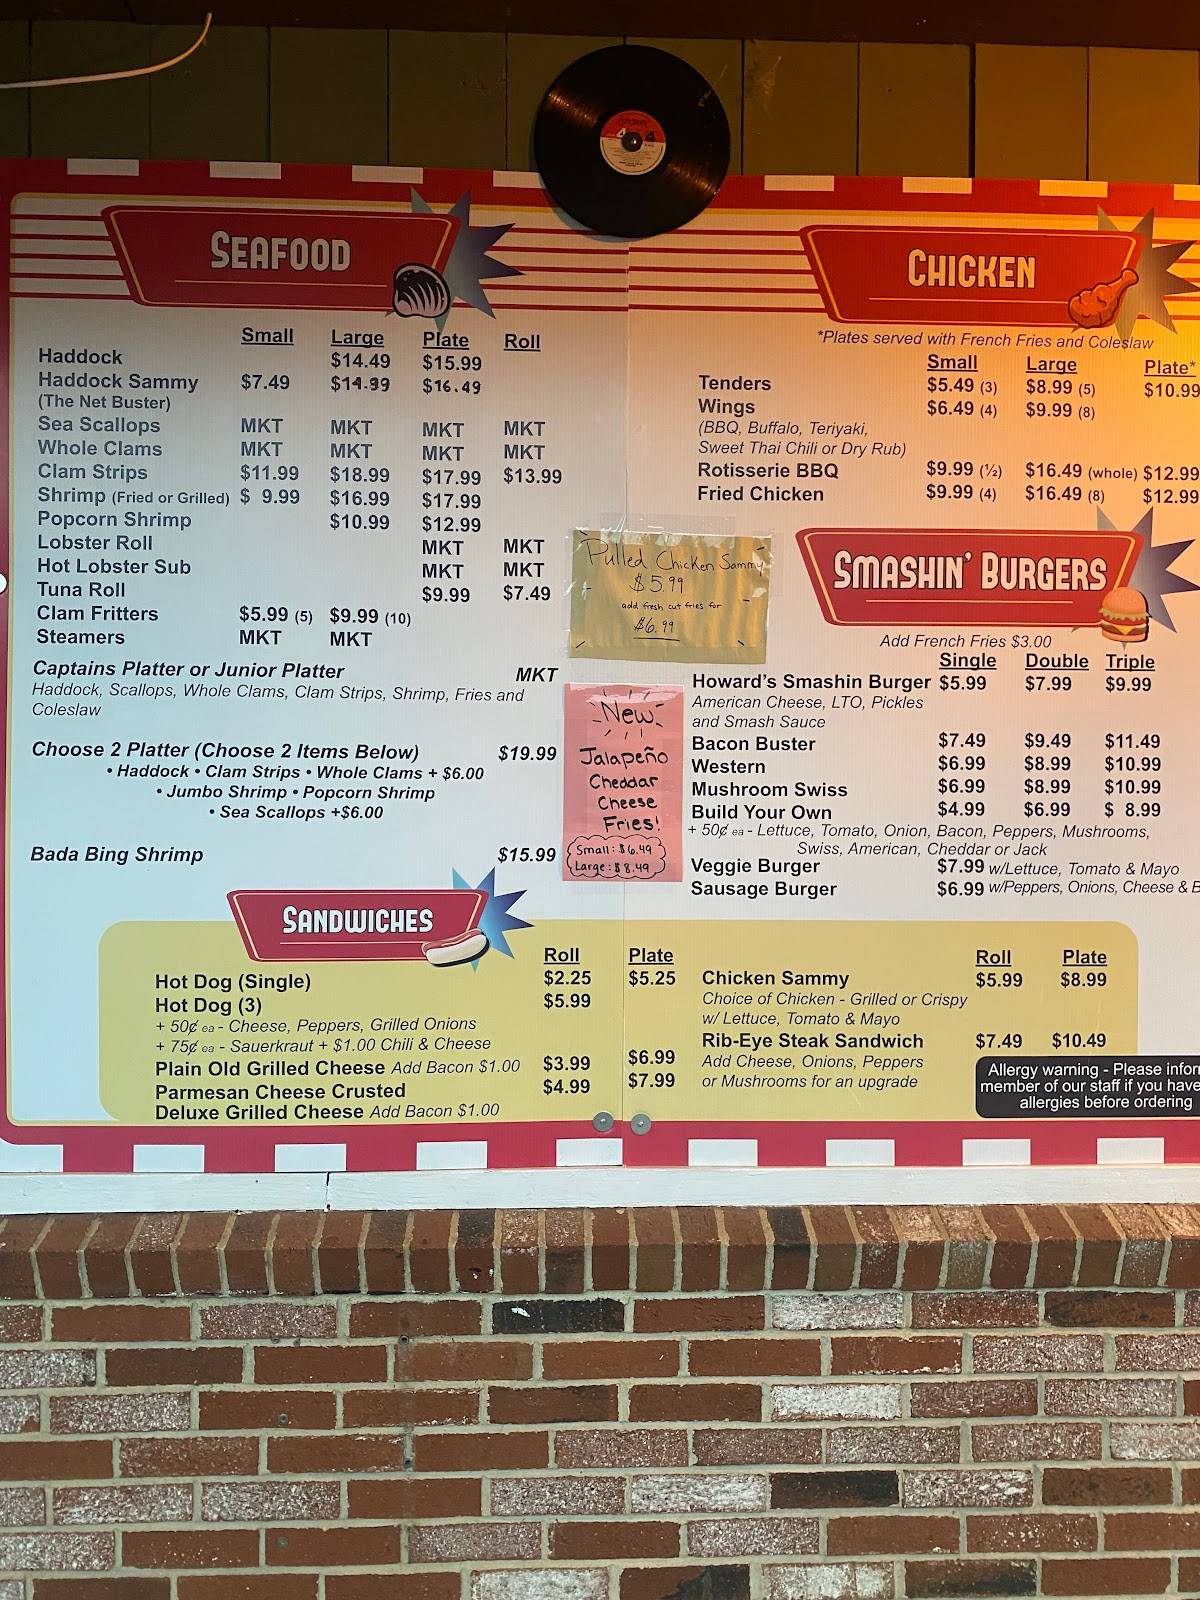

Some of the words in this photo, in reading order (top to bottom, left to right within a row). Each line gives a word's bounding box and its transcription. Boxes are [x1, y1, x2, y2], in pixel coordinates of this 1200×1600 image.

[210, 230, 351, 272] SEAFOOD
[908, 248, 1036, 289] CHICKEN
[241, 327, 294, 345] Small
[331, 329, 384, 347] Large
[423, 331, 469, 348] Plate
[504, 333, 541, 350] Roll
[873, 332, 923, 345] served
[927, 332, 956, 345] with
[961, 333, 1011, 346] French
[1016, 334, 1052, 347] Fries
[1056, 335, 1084, 348] and
[1089, 333, 1154, 350] Coleslaw
[39, 348, 123, 364] Haddock
[331, 352, 390, 369] $14.49
[423, 354, 481, 372] $15.99
[927, 353, 978, 371] Small
[1026, 356, 1077, 374] Large
[39, 371, 122, 388] Haddock
[129, 373, 199, 393] Sammy
[423, 377, 481, 395] $16.49
[698, 375, 771, 391] Tenders
[927, 376, 974, 393] $5.49
[980, 381, 997, 396] (3)
[1026, 378, 1072, 395] $8.99
[1079, 383, 1095, 398] (5)
[39, 394, 74, 410] (The
[80, 395, 106, 408] Net
[112, 395, 170, 413] Buster)
[698, 398, 755, 418] Wings
[38, 416, 73, 431] Sea
[80, 416, 160, 436] Scallops
[241, 418, 283, 433] MKT
[699, 420, 741, 437] (BBQ,
[748, 421, 802, 436] Buffalo,
[810, 421, 867, 438] Teriyaki,
[698, 440, 744, 454] Sweet
[750, 441, 781, 454] Thai
[786, 441, 818, 455] Chili
[822, 445, 838, 455] or
[841, 442, 867, 458] Dry
[871, 442, 906, 458] Rub)
[38, 463, 86, 479] Clam
[93, 464, 147, 483] Strips
[504, 467, 562, 484] $13.99
[698, 462, 790, 478] Rotisserie
[797, 463, 839, 479] BBQ
[1026, 462, 1082, 478] $16.49
[1088, 467, 1137, 482] (whole)
[38, 487, 106, 506] Shrimp
[112, 491, 153, 506] (Fried
[158, 495, 173, 503] or
[178, 492, 229, 507] Grilled)
[580, 538, 647, 569] Pulled
[656, 550, 714, 571] Chicken
[719, 553, 765, 576] Sammy
[833, 550, 972, 590] SMASHIN'
[981, 551, 1107, 591] BURGERS
[37, 605, 84, 620] Clam
[92, 606, 158, 621] Fritters
[240, 605, 288, 623] $5.99
[295, 610, 312, 625] (5)
[643, 601, 664, 611] fresh
[685, 602, 703, 611] fries
[709, 601, 722, 610] for
[633, 617, 674, 634] $6.99
[37, 628, 125, 644] Steamers
[879, 634, 910, 647] Add
[914, 634, 965, 647] French
[970, 635, 1006, 648] Fries
[1011, 635, 1052, 648] $3.00
[34, 660, 116, 679] Captains
[122, 661, 185, 676] Platter
[190, 665, 210, 676] or
[215, 662, 277, 677] Junior
[281, 663, 346, 679] Platter
[939, 652, 997, 671] Single
[1025, 653, 1089, 670] Double
[1105, 654, 1155, 672] Triple
[693, 674, 776, 688] Howard's
[783, 674, 862, 688] Smashin
[869, 674, 932, 693] Burger
[692, 695, 761, 708] American
[767, 695, 825, 710] Cheese,
[832, 695, 865, 710] LTO,
[871, 696, 924, 709] Pickles
[600, 700, 655, 725] New
[692, 715, 720, 728] and
[724, 715, 774, 728] Smash
[780, 715, 826, 728] Sauce
[693, 736, 749, 750] Bacon
[756, 736, 816, 751] Buster
[1105, 733, 1160, 750] $11.49
[498, 745, 557, 762] $19.99
[579, 746, 669, 770] Jalapeño
[691, 759, 765, 773] Western
[589, 773, 659, 789] Cheddar
[692, 782, 788, 796] Mushroom
[794, 782, 847, 797] Swiss
[598, 795, 658, 810] Cheese
[603, 815, 661, 833] Fries!
[31, 846, 78, 861] Bada
[85, 846, 129, 865] Bing
[135, 847, 203, 865] Shrimp
[282, 904, 434, 934] SANDWICHES
[544, 947, 580, 964] Roll
[628, 948, 674, 965] Plate
[975, 949, 1012, 966] Roll
[1062, 949, 1108, 966] Plate
[156, 974, 188, 989] Hot
[194, 974, 231, 993] Dog
[239, 973, 310, 992] (Single)
[544, 970, 591, 987] $2.25
[703, 970, 775, 985] Chicken
[782, 970, 849, 989] Sammy
[703, 1033, 772, 1052] Rib-Eye
[779, 1033, 829, 1048] Steak
[835, 1033, 923, 1048] Sandwich
[1052, 1032, 1106, 1049] $10.49
[156, 1061, 201, 1076] Plain
[208, 1061, 240, 1076] Old
[247, 1061, 309, 1076] Grilled
[316, 1060, 385, 1075] Cheese
[391, 1061, 422, 1074] Add
[426, 1061, 473, 1074] Bacon
[479, 1059, 520, 1073] $1.00
[989, 1063, 1038, 1079] Allergy
[1042, 1063, 1098, 1079] warning
[1114, 1063, 1162, 1075] Please
[981, 1079, 1040, 1092] member
[1044, 1079, 1059, 1092] of
[1062, 1082, 1086, 1092] our
[1090, 1079, 1121, 1092] staff
[1125, 1078, 1133, 1092] if
[1137, 1082, 1162, 1095] you
[1167, 1079, 1200, 1091] have
[1020, 1095, 1080, 1112] allergies
[1085, 1095, 1129, 1108] before
[1134, 1094, 1192, 1111] ordering
